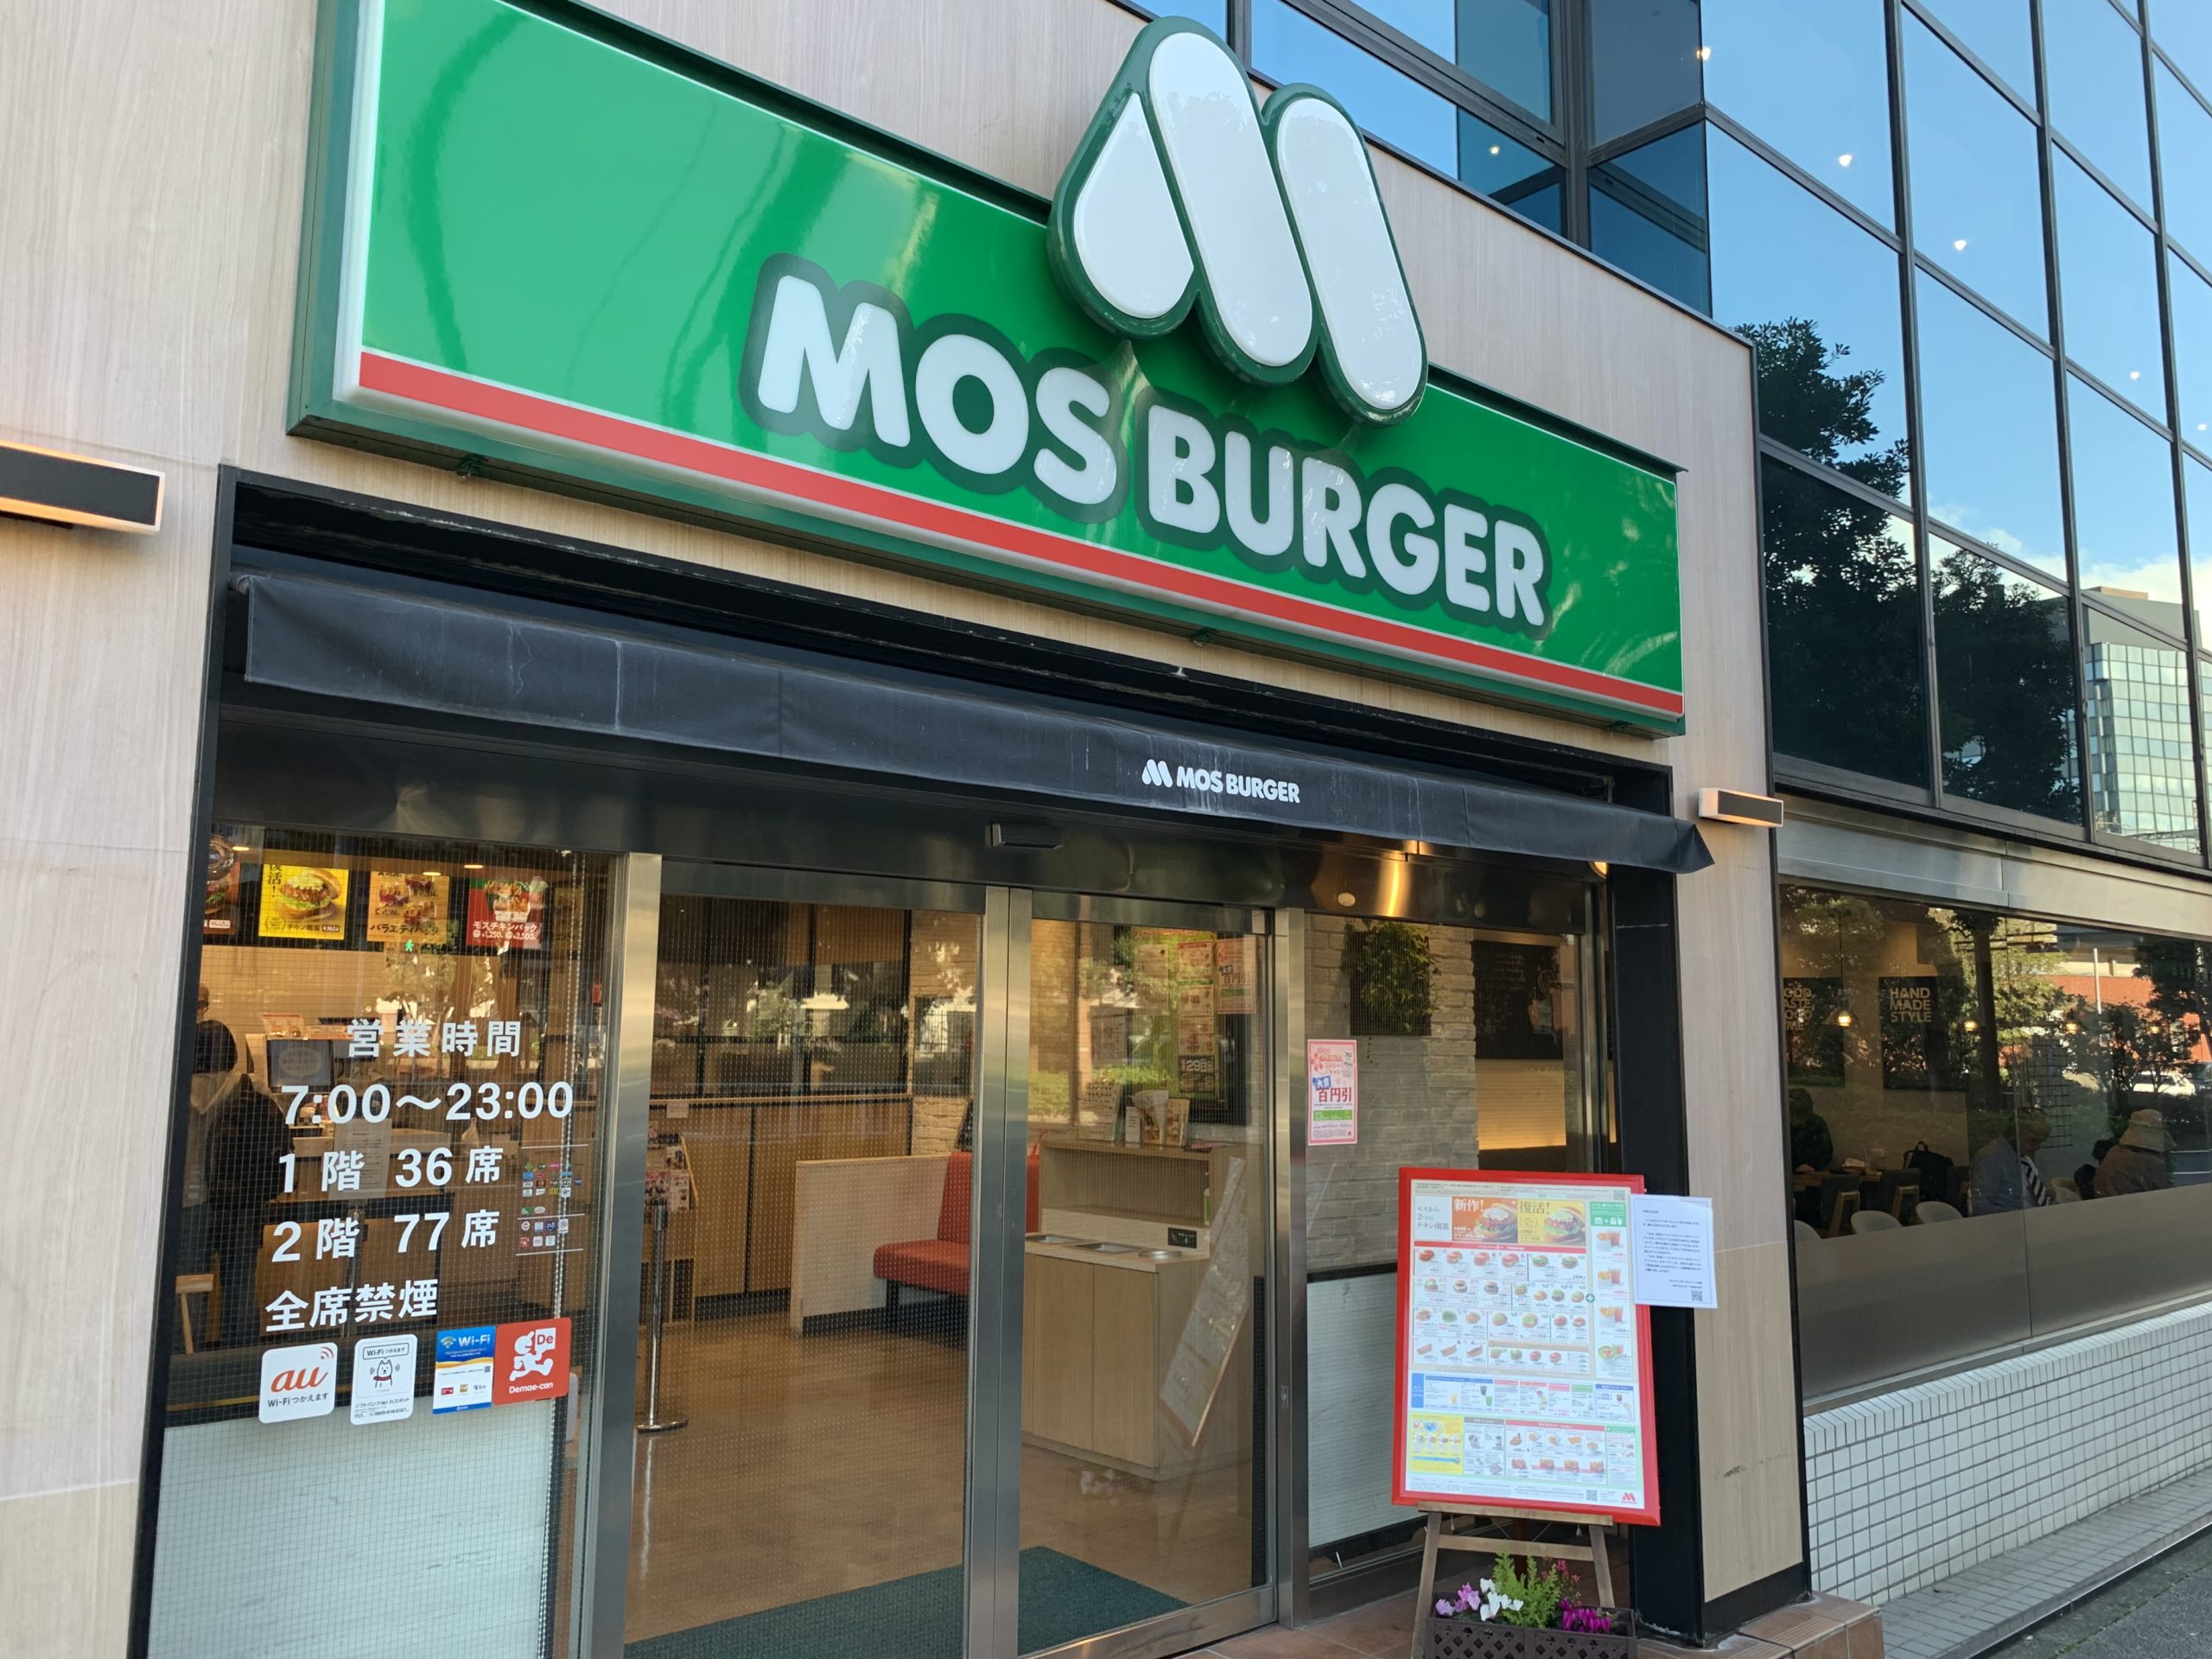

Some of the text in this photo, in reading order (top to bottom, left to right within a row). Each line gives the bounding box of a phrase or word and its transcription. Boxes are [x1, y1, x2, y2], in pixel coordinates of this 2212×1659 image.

[758, 275, 1544, 626] MOS BURGER
[1176, 766, 1224, 793] MOS
[1225, 773, 1300, 804] BURGER
[473, 921, 538, 933] モスチキンパック
[1783, 988, 1812, 998] OOD
[1890, 988, 1930, 999] HAND
[1890, 1000, 1931, 1011] MADE
[1784, 1010, 1812, 1020] OOD
[1891, 1012, 1932, 1023] STYLE
[347, 1018, 521, 1058] 営業時間
[1319, 1087, 1351, 1103] 百円引
[1453, 1198, 1550, 1215] 新作! 復活!
[265, 1279, 439, 1332] 全席禁煙
[458, 1334, 491, 1348] Wi-Fi
[537, 1334, 554, 1345] De
[270, 1366, 328, 1392] au
[509, 1382, 553, 1394] Demae-can
